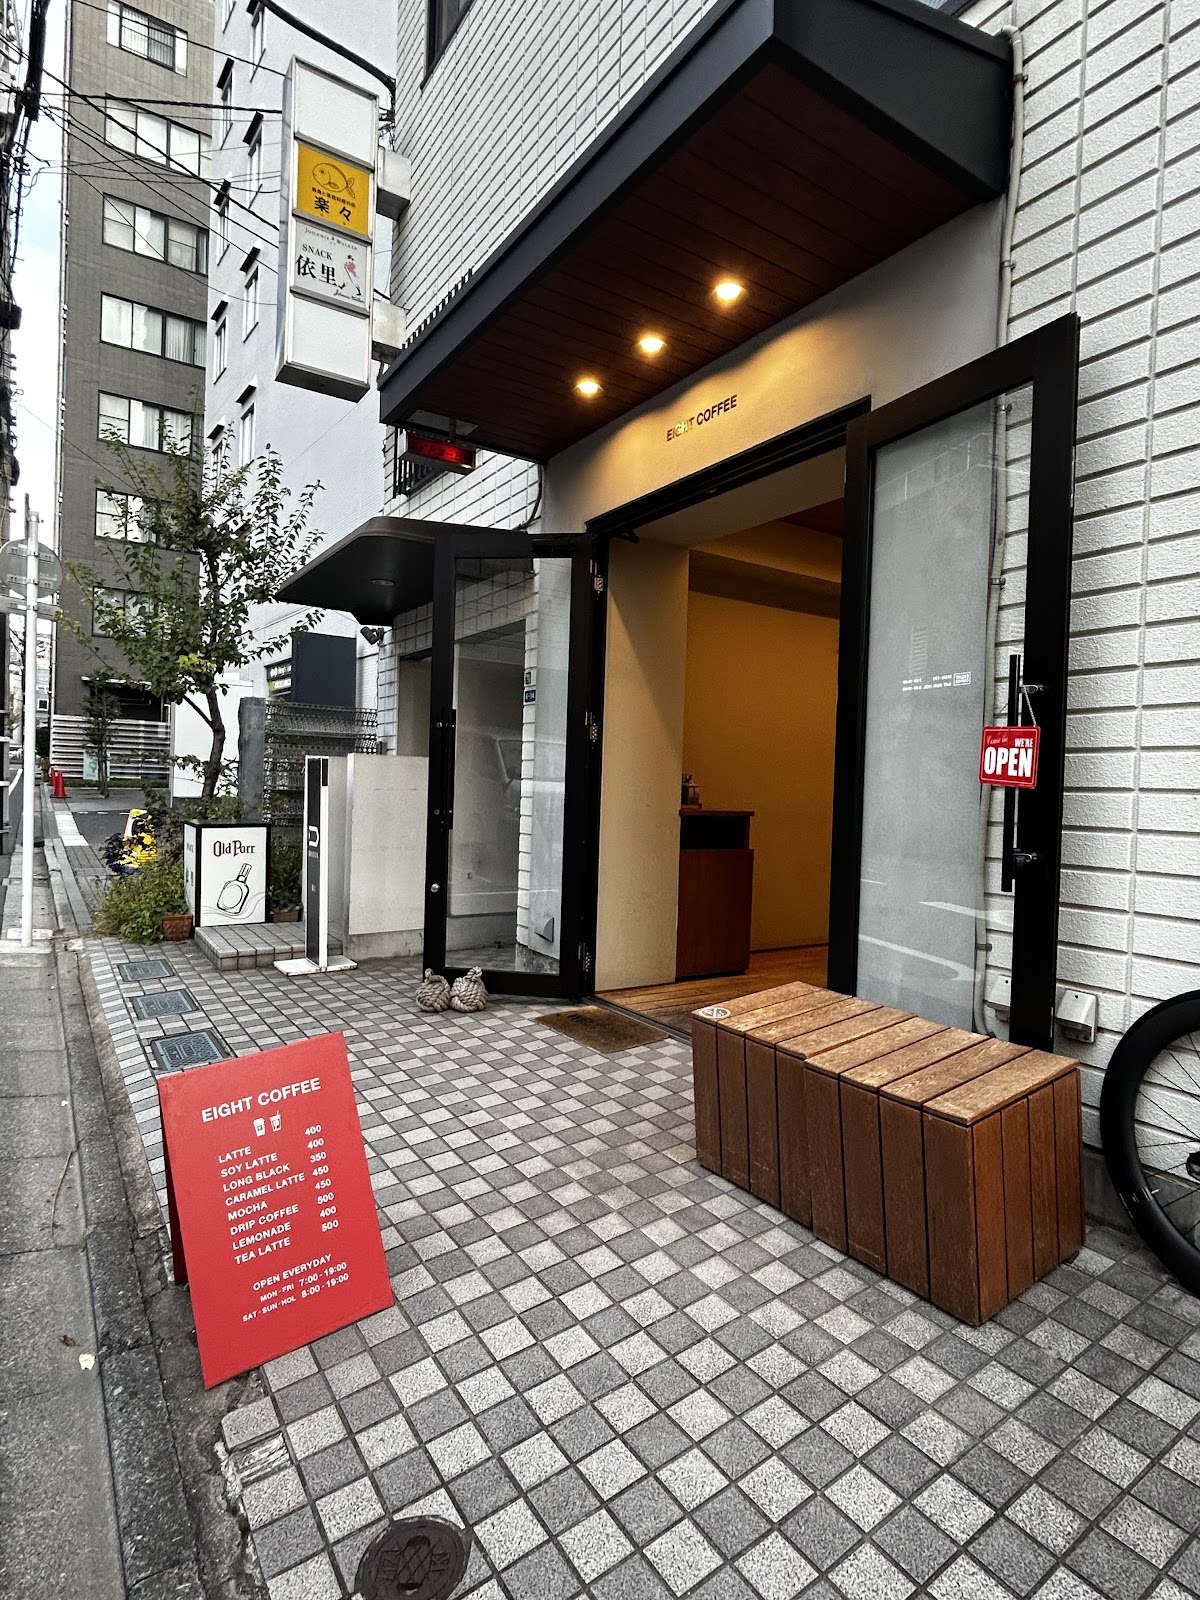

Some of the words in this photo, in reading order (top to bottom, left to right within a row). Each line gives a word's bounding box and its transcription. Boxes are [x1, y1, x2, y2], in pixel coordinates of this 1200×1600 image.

[315, 194, 352, 222] 楽々
[296, 254, 337, 287] 依里
[302, 243, 333, 261] SNACK
[667, 416, 695, 442] EIGHT
[696, 394, 738, 426] COFFEE
[984, 746, 1033, 778] OPEN
[213, 840, 231, 857] Old
[232, 839, 256, 857] Parr
[201, 1096, 253, 1123] EIGHT
[257, 1077, 321, 1106] COFFEE
[218, 1146, 252, 1164] LATTE
[304, 1124, 322, 1136] 400
[220, 1164, 243, 1178] SOY
[245, 1152, 278, 1170] LATTE
[307, 1138, 325, 1149] 400
[223, 1175, 253, 1193] LONG
[255, 1163, 291, 1182] BLACK
[309, 1151, 327, 1164] 350
[225, 1184, 274, 1207] CARAMEL
[275, 1172, 306, 1190] LATTE
[312, 1164, 330, 1177] 450
[227, 1200, 269, 1222] MOCHA
[314, 1178, 332, 1190] 450
[230, 1219, 256, 1236] DRIP
[258, 1204, 299, 1225] COFFEE
[317, 1192, 335, 1205] 500
[232, 1221, 292, 1251] LEMONADE
[319, 1205, 337, 1218] 400
[234, 1250, 257, 1265] TEA
[258, 1237, 292, 1257] LATTE
[321, 1219, 339, 1232] 500
[252, 1273, 281, 1291] OPEN
[282, 1253, 332, 1280] EVERYDAY
[299, 1273, 319, 1287] 7:00
[324, 1261, 347, 1276] 19:00
[301, 1284, 321, 1299] 8:00
[326, 1273, 349, 1288] 19:00
